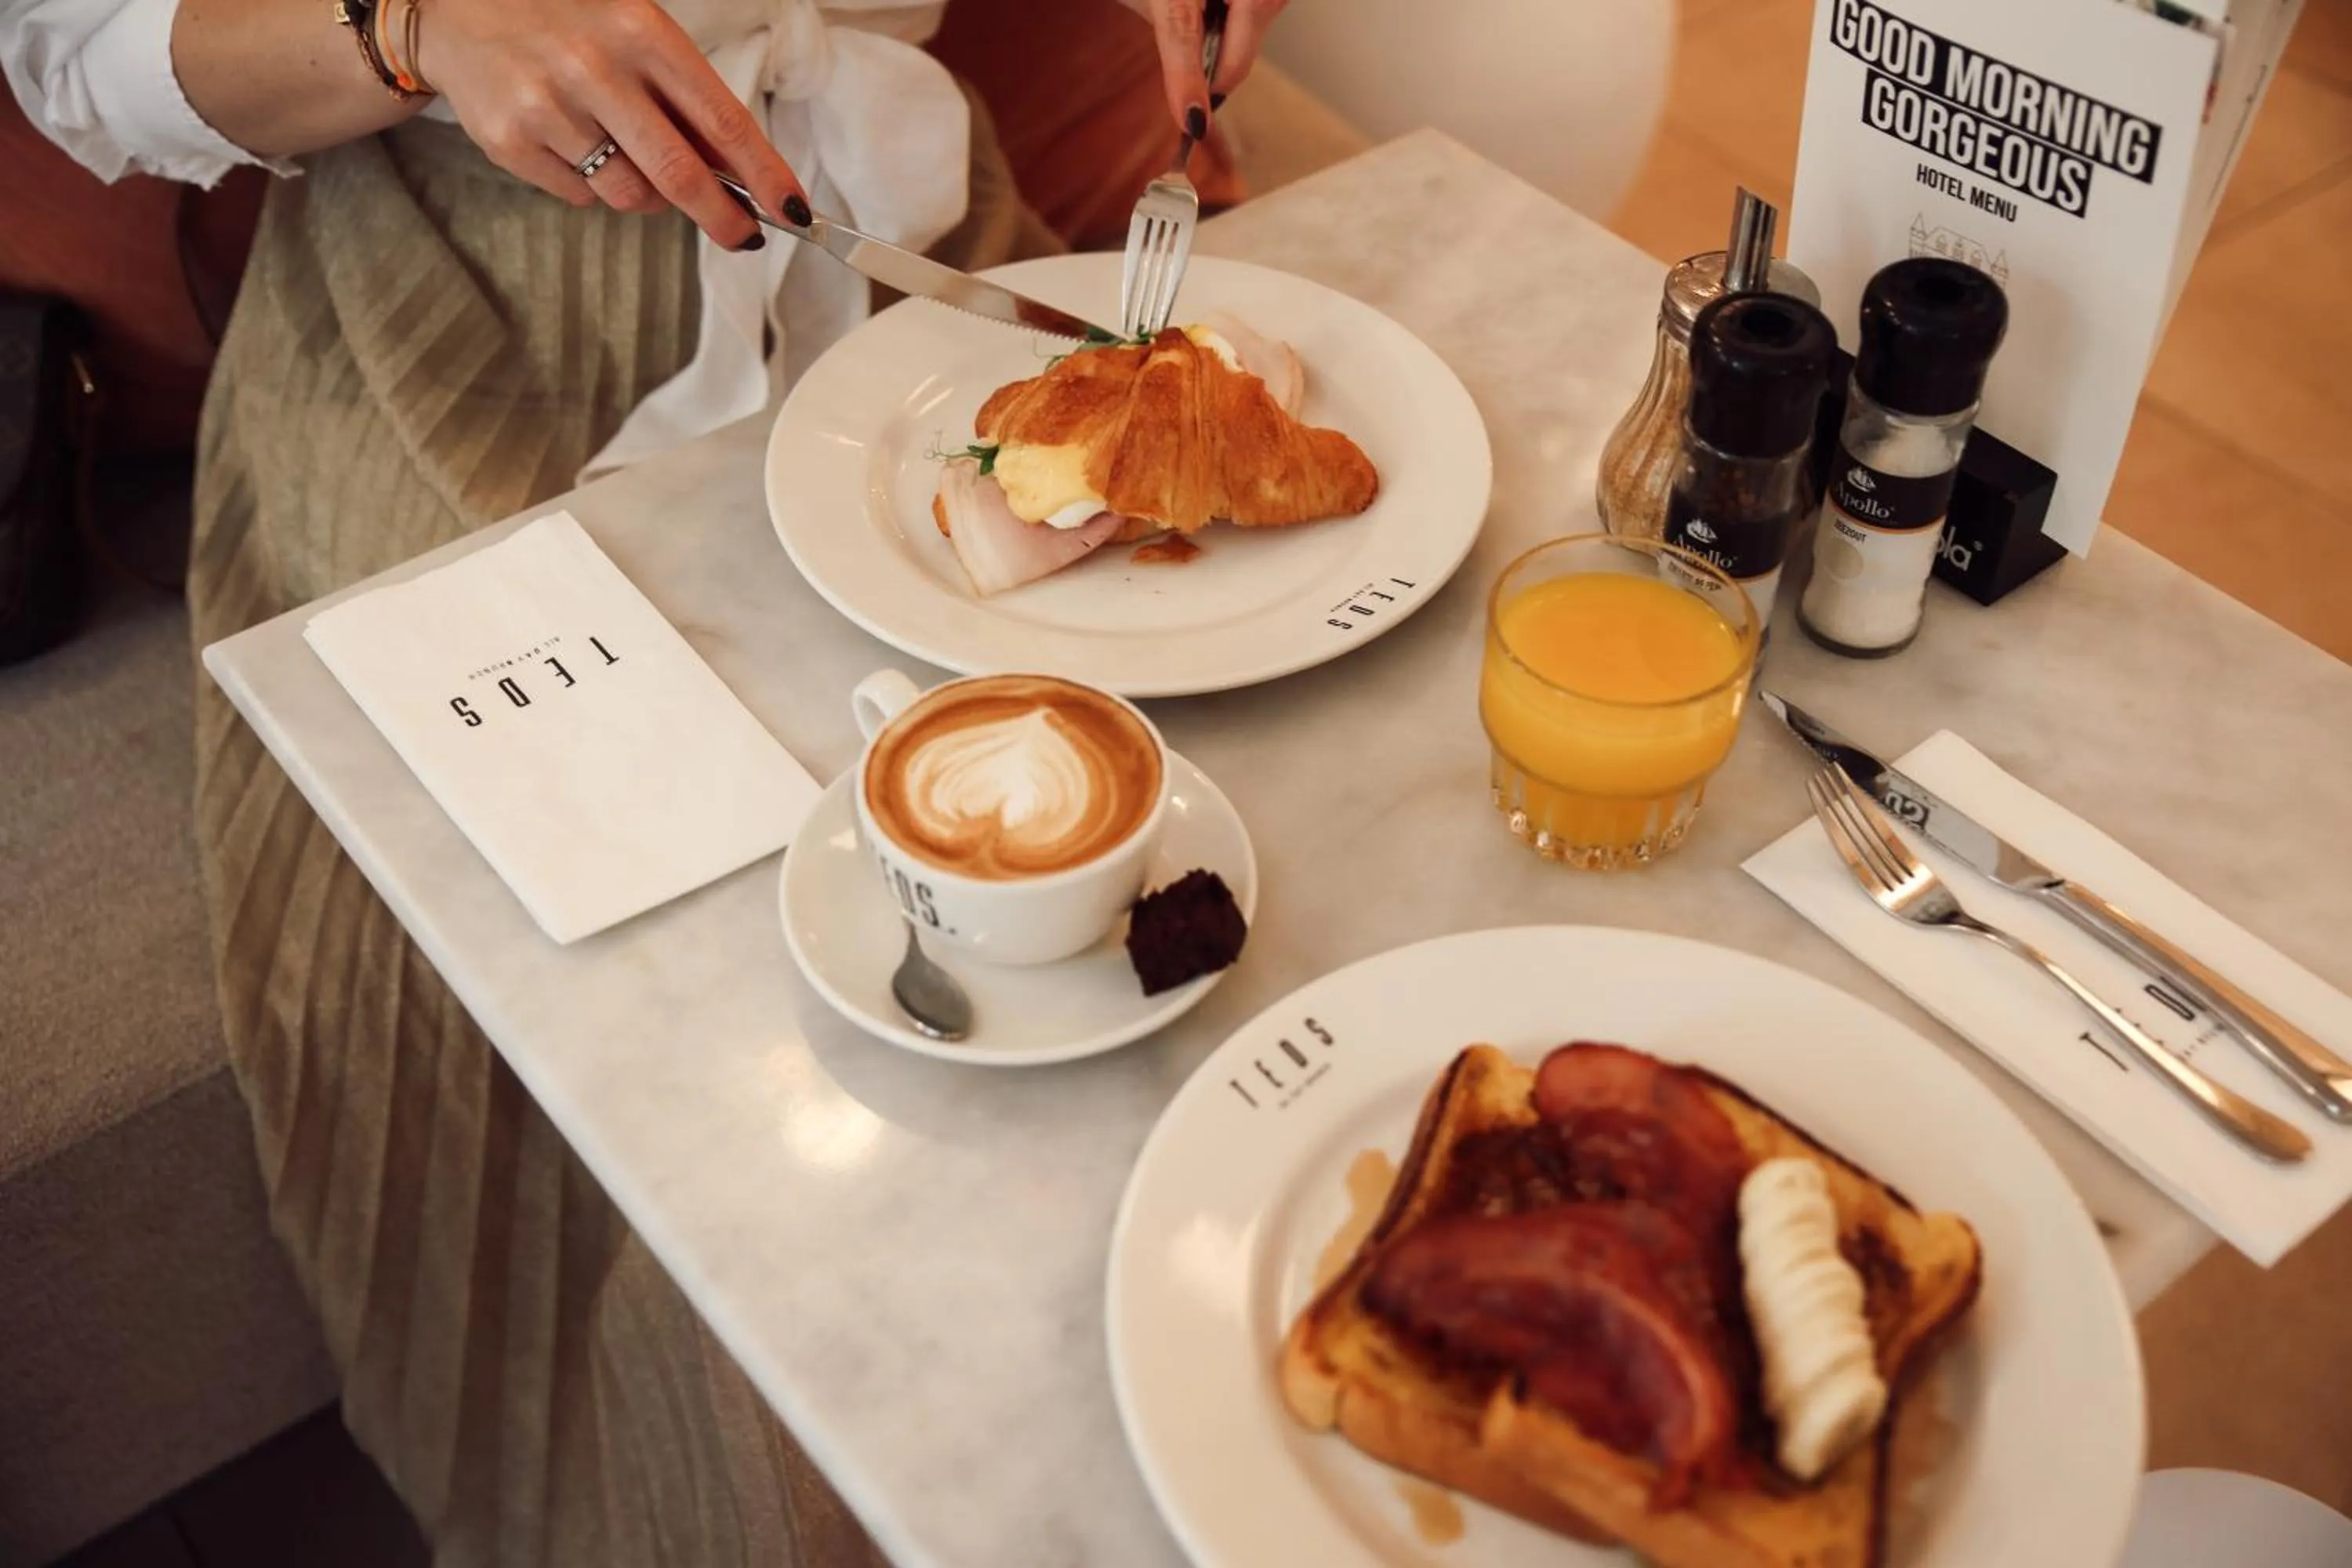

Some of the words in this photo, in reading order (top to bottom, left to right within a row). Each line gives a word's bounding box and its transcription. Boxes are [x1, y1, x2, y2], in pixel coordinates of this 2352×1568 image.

[1835, 0, 1936, 87] GOOD
[1944, 45, 2152, 176] MORNING
[1868, 76, 2087, 214] GORGEOUS
[1915, 162, 1966, 201] HOTEL
[1969, 186, 2018, 223] MENU
[1327, 577, 1416, 630] TEDS
[449, 636, 619, 727] TEDS
[1229, 1017, 1334, 1109] TEDS
